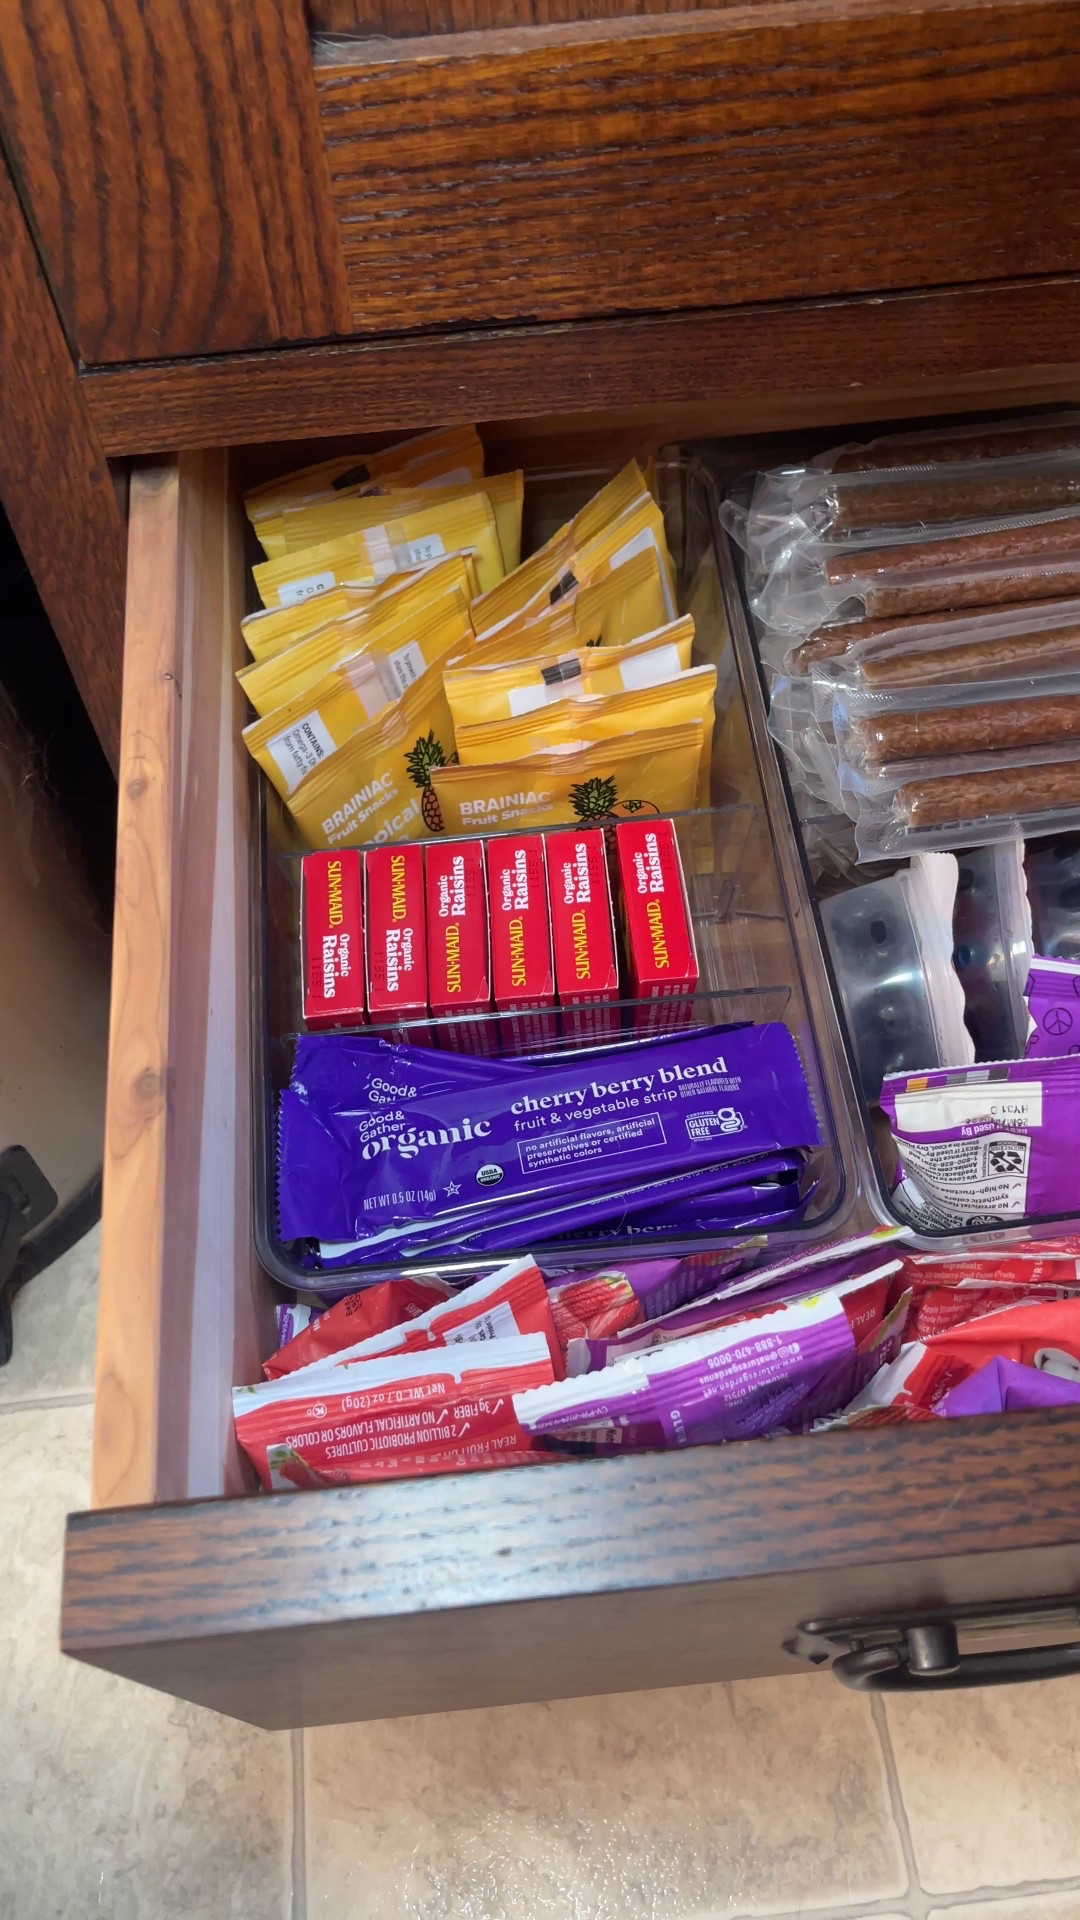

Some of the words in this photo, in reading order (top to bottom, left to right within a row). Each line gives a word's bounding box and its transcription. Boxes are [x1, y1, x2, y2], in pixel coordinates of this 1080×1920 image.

[302, 722, 325, 759] CONTAINS:
[284, 736, 294, 752] from
[292, 750, 304, 768] fatty
[322, 772, 394, 834] BRAINIAC
[459, 791, 550, 816] BRAINIAC
[328, 820, 359, 845] Fruit
[358, 788, 399, 823] Snacks
[462, 815, 499, 826] Fruit
[502, 804, 554, 821] Snacks
[573, 843, 592, 903] Raisins
[632, 852, 647, 894] Organic
[644, 833, 665, 893] Raisins
[450, 856, 466, 916] Raisins
[500, 868, 514, 911] Organic
[512, 850, 529, 910] Raisins
[561, 862, 575, 904] Organic
[438, 875, 451, 917] Organic
[338, 934, 351, 977] Organic
[386, 928, 403, 992] Raisins
[401, 928, 415, 971] Organic
[322, 934, 339, 998] Raisins
[510, 1088, 588, 1115] cherry
[590, 1073, 656, 1099] berry
[658, 1056, 729, 1084] blend
[719, 1084, 740, 1092] FLAVORS
[514, 1115, 547, 1132] fruit
[550, 1112, 562, 1124] &
[564, 1096, 640, 1122] vegetable
[644, 1088, 678, 1105] strip
[686, 1110, 714, 1119] CERTIFIED
[360, 1122, 406, 1143] Gather
[689, 1118, 720, 1129] GLUTEN
[691, 1126, 711, 1137] FREE
[961, 1127, 973, 1136] By
[974, 1123, 995, 1134] Used
[362, 1118, 492, 1160] organic
[526, 1144, 538, 1152] no
[539, 1132, 579, 1149] artificial
[578, 1128, 615, 1142] flavors,
[616, 1118, 656, 1133] artificial
[527, 1140, 591, 1161] preservatives
[592, 1138, 602, 1147] or
[603, 1128, 644, 1144] certified
[528, 1152, 572, 1169] synthetic
[574, 1146, 603, 1159] colors
[943, 1151, 978, 1161] Reference
[481, 1168, 498, 1177] USDA
[364, 1196, 378, 1211] NET
[378, 1194, 391, 1207] WT
[392, 1192, 405, 1205] 0.5
[406, 1192, 416, 1202] OZ
[418, 1189, 437, 1203] (14g)
[972, 1194, 1009, 1203] synthetic
[708, 1335, 783, 1370] 1-888-470-0006
[700, 1352, 778, 1384] @naturesgardenus
[703, 1354, 804, 1399] www.naturesgarden.net
[373, 1394, 385, 1403] oz
[387, 1390, 403, 1403] 0.7
[405, 1388, 425, 1400] Wt.
[426, 1382, 446, 1395] Net
[341, 1395, 371, 1413] (20g)
[454, 1402, 479, 1420] FIBER
[479, 1398, 492, 1413] 3g
[377, 1414, 421, 1430] ARTIFICIAL
[422, 1410, 436, 1425] NO
[286, 1432, 321, 1449] COLORS
[321, 1431, 334, 1443] OR
[334, 1420, 374, 1440] FLAVORS
[370, 1431, 416, 1451] PROBIOTIC
[416, 1426, 451, 1443] BILLION
[452, 1424, 457, 1437] 2
[325, 1438, 369, 1459] CULTURES
[493, 1434, 517, 1449] REAL
